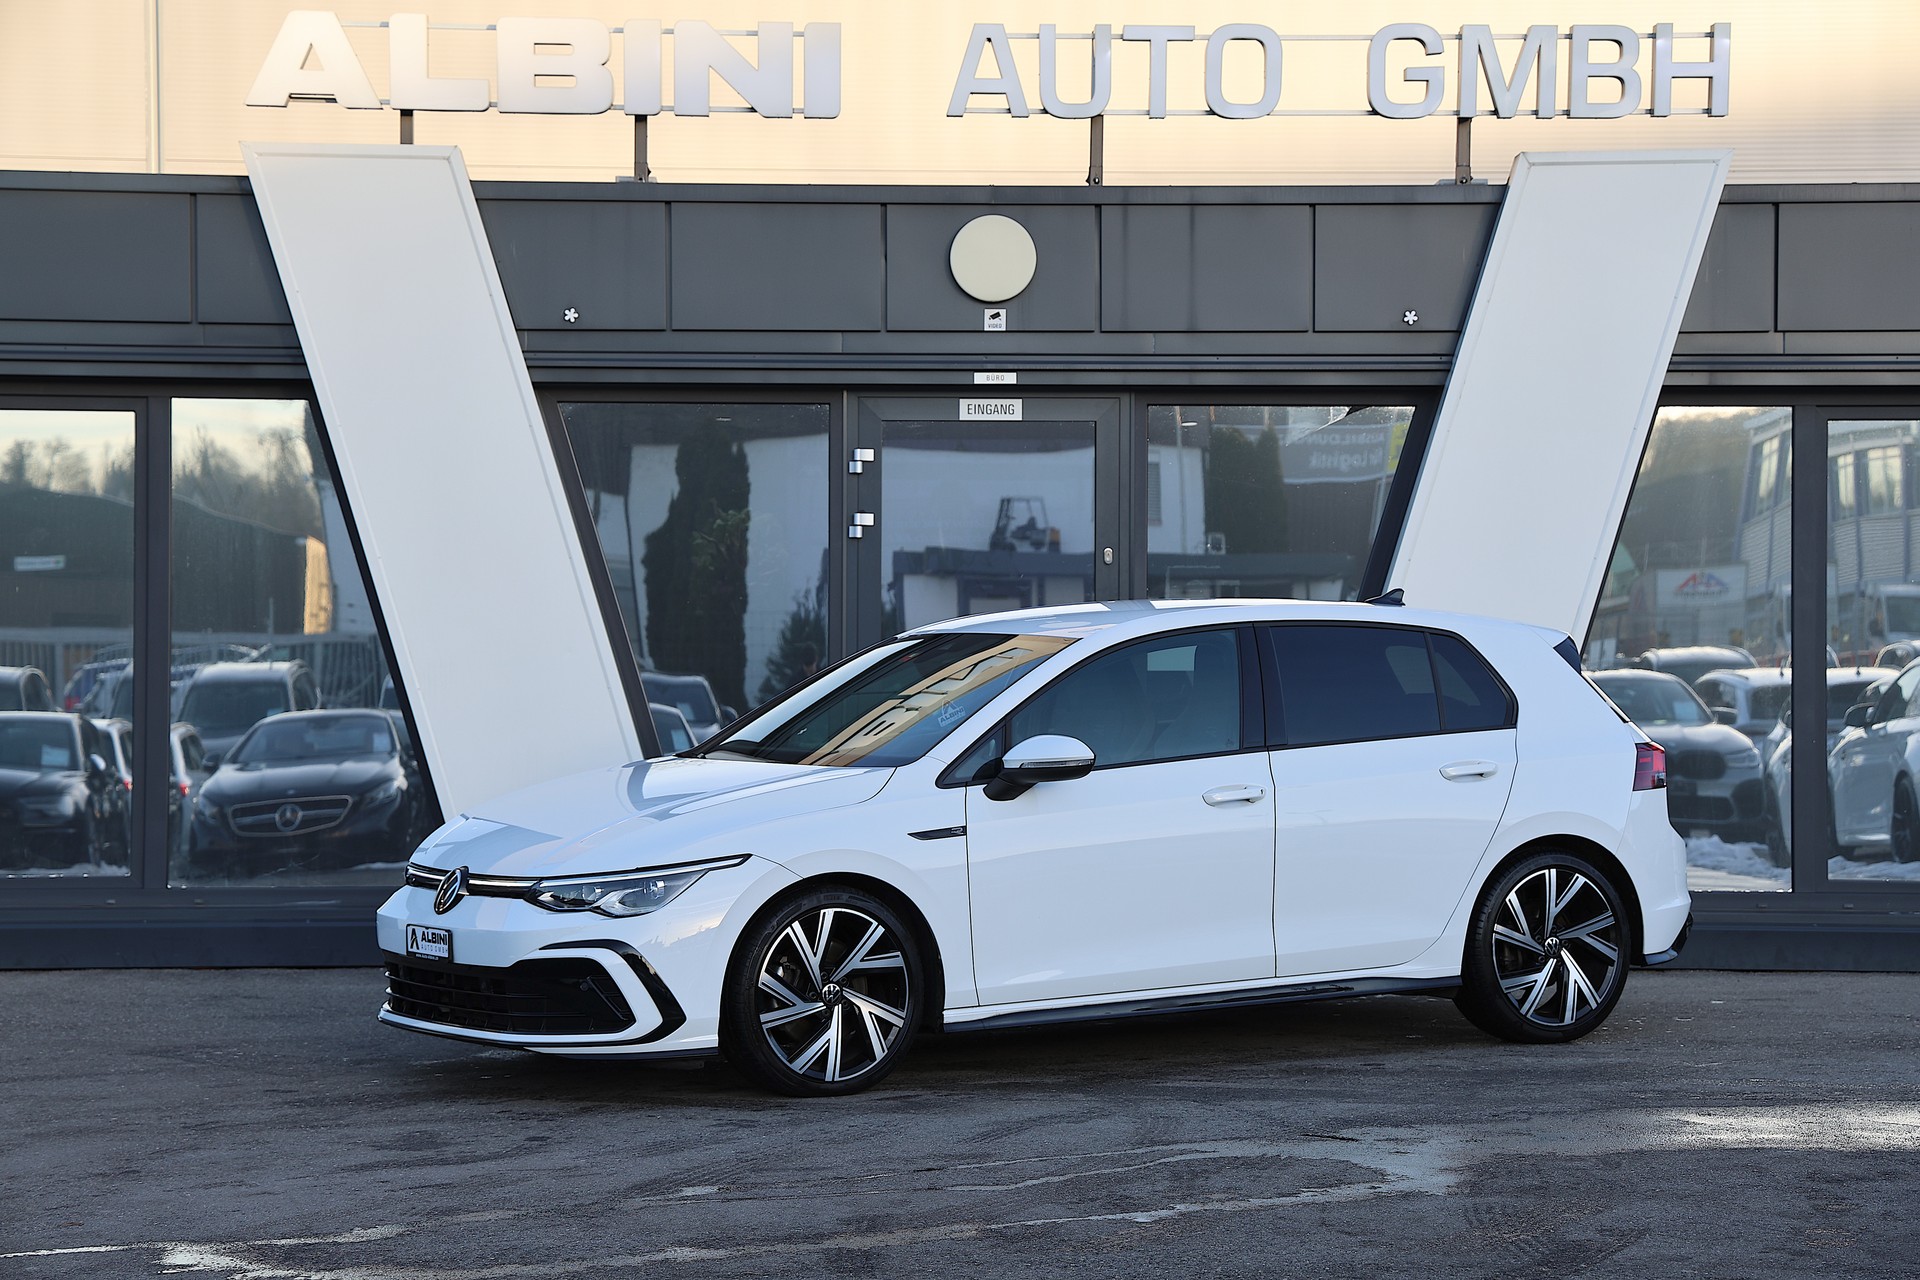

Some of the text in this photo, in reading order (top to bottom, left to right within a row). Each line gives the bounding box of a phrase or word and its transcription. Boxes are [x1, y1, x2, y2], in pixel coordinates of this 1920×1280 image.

[246, 10, 1731, 119] ALBINI AUTO GMBH
[967, 403, 1015, 415] EINGANG
[421, 930, 448, 946] ALBINI
